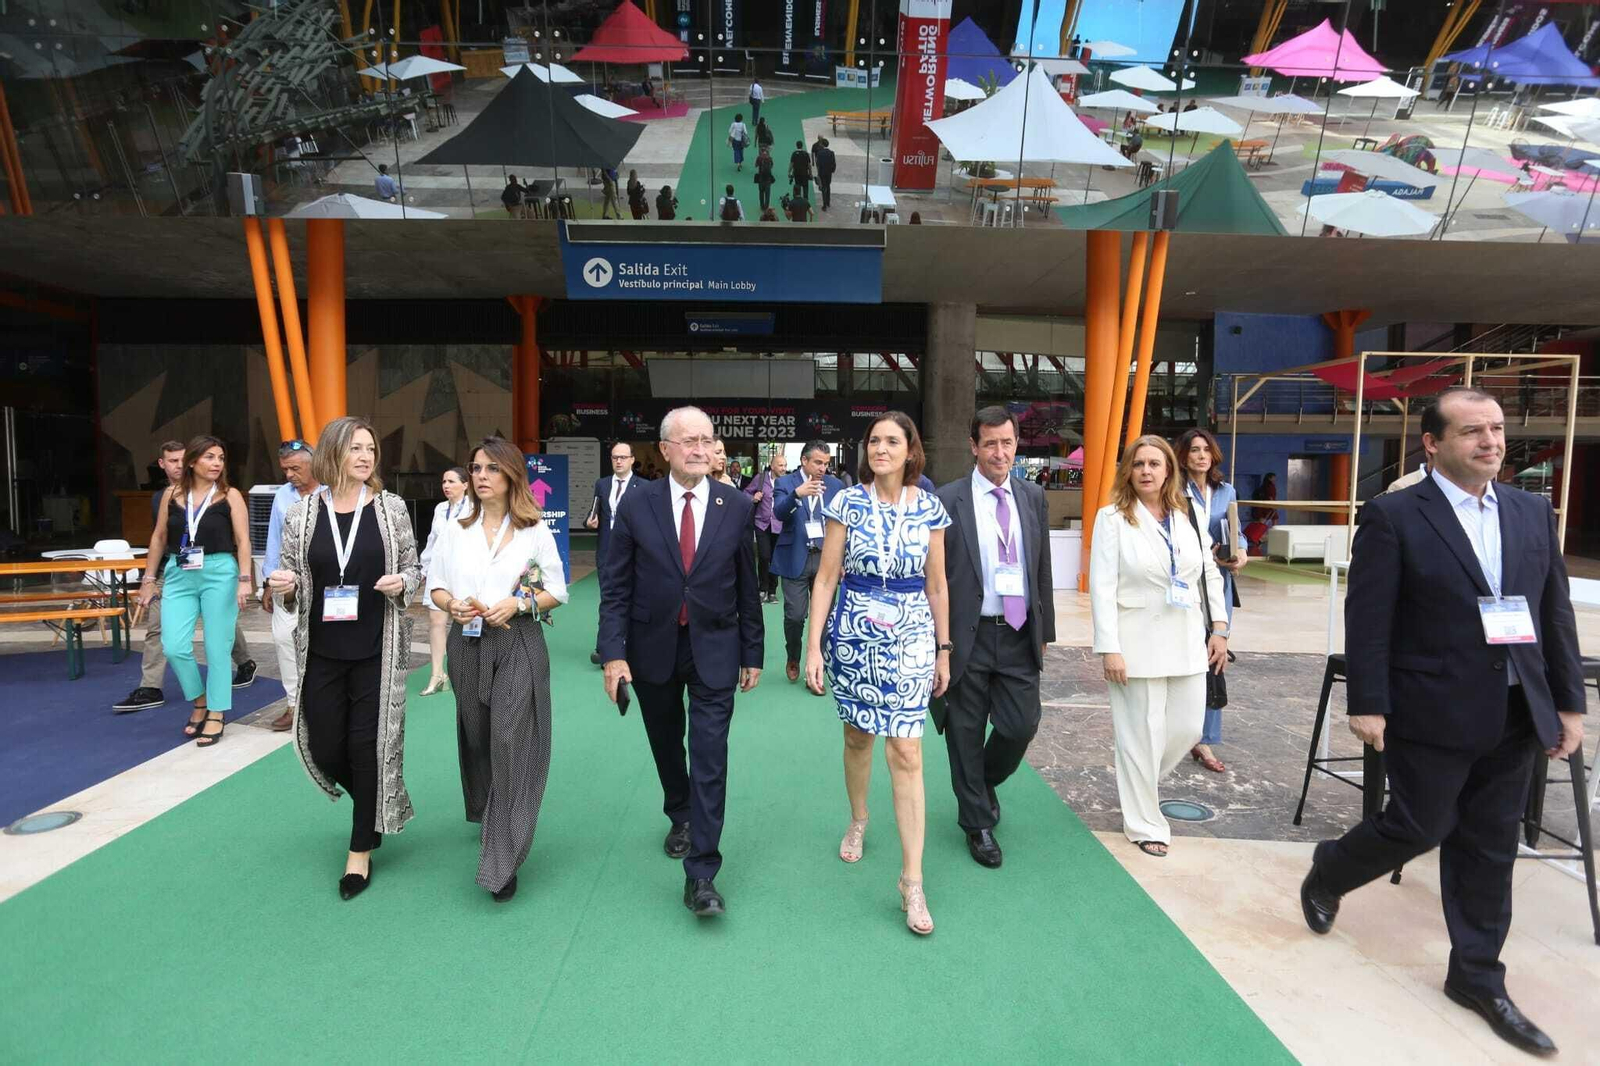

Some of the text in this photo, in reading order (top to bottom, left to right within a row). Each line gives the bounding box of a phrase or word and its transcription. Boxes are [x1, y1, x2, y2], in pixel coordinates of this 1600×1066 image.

[619, 262, 688, 276] Salida Exit
[619, 279, 756, 291] Vestíbulo principal Main Lobby
[723, 415, 758, 425] NEXT
[760, 415, 796, 425] YEAR
[714, 426, 796, 437] JUNE 2023
